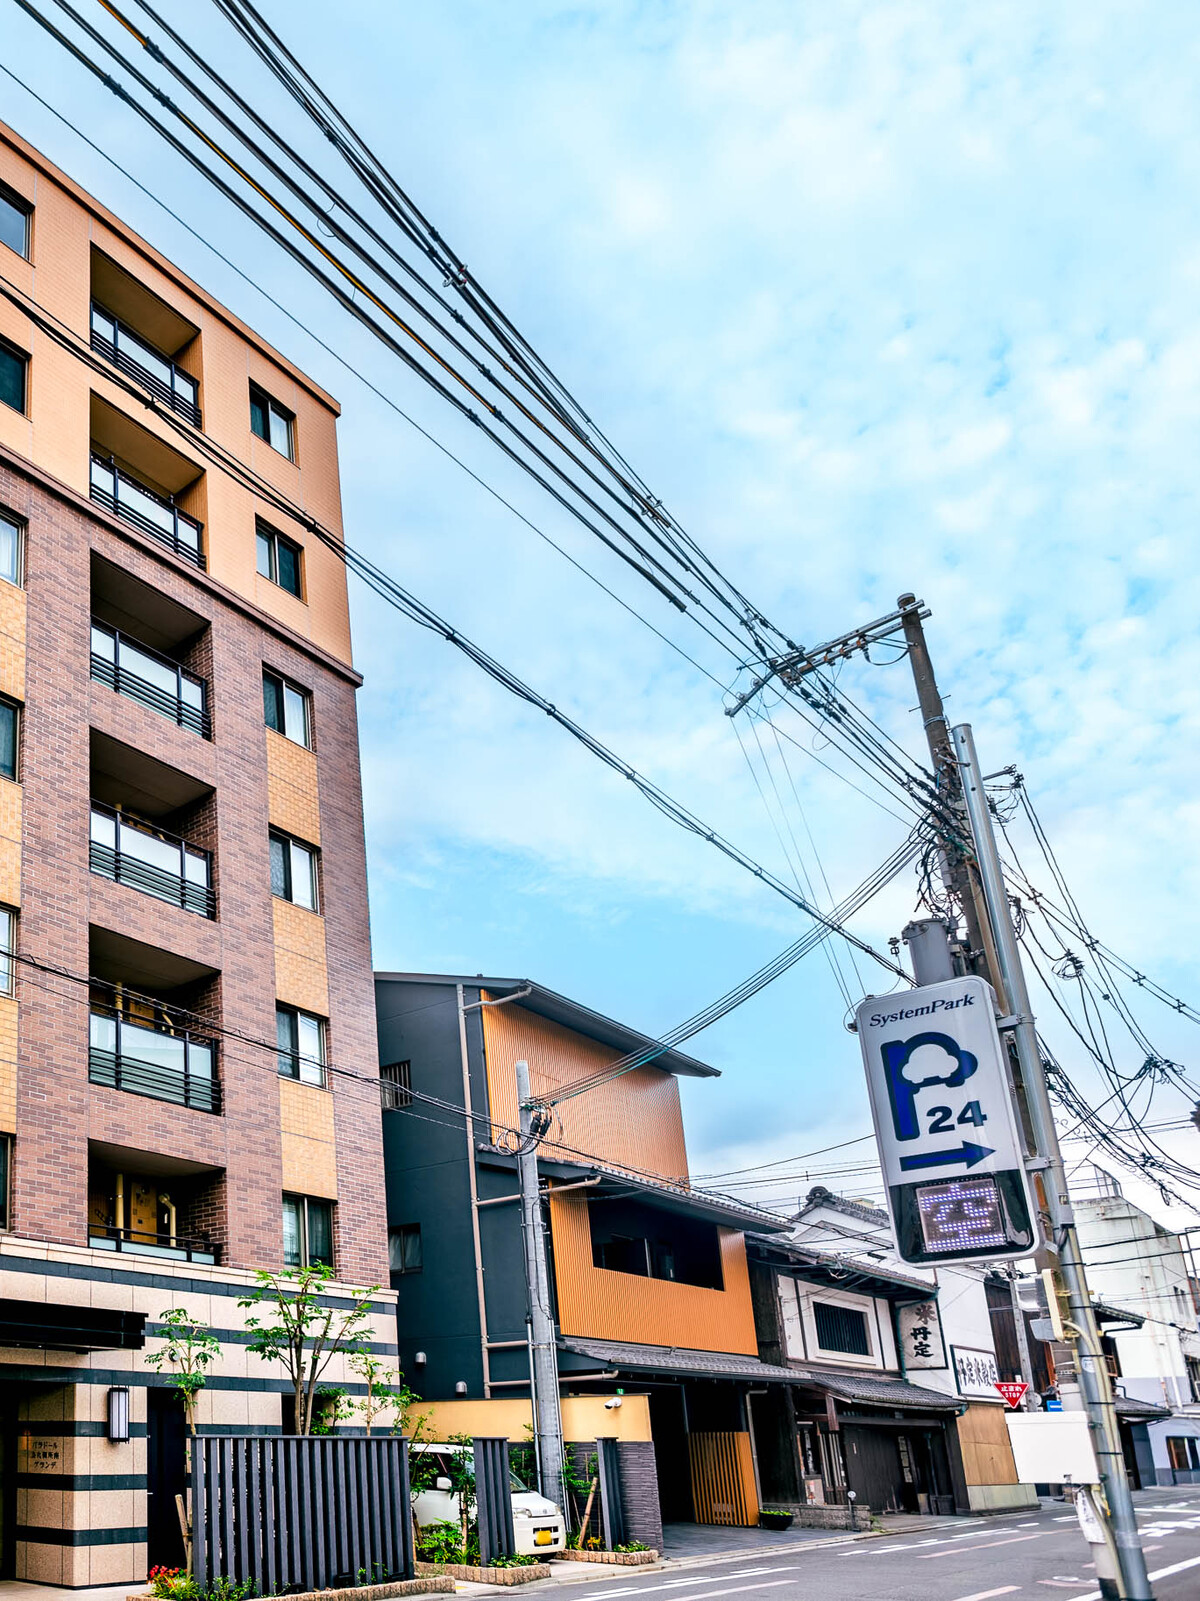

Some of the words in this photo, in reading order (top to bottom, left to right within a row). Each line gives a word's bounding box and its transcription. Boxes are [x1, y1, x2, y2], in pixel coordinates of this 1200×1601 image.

[869, 994, 975, 1028] SystemPark
[926, 1099, 988, 1134] 24
[919, 1182, 1007, 1250] 空
